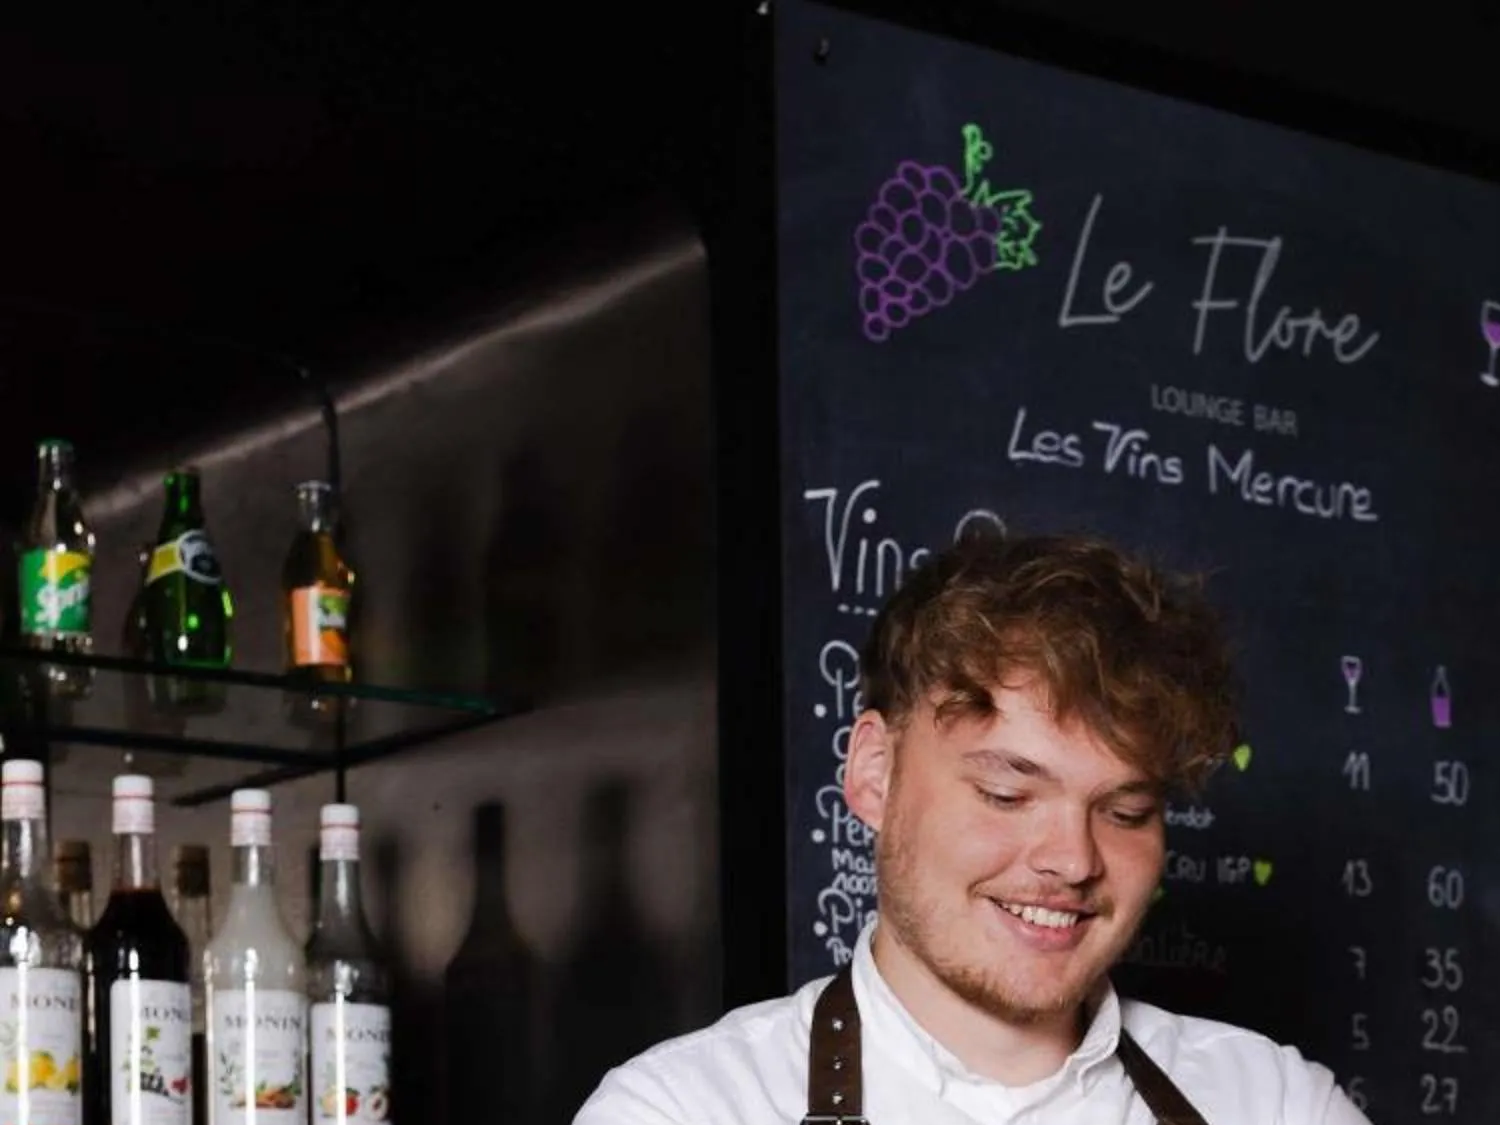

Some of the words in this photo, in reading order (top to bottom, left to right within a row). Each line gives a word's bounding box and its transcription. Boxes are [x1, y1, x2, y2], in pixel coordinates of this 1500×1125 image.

[1058, 194, 1154, 328] Le
[1192, 226, 1380, 364] Flore
[1150, 384, 1243, 429] LOUNGE
[1254, 408, 1299, 437] BAR
[1008, 408, 1084, 468] Les
[1093, 421, 1184, 485] Vins
[1207, 444, 1379, 523] Mercure
[1431, 761, 1469, 806] 50
[1342, 860, 1372, 897] 13
[1427, 866, 1465, 909] 60
[1420, 947, 1465, 992] 35
[1421, 1005, 1467, 1054] 22
[1420, 1076, 1458, 1114] 27
